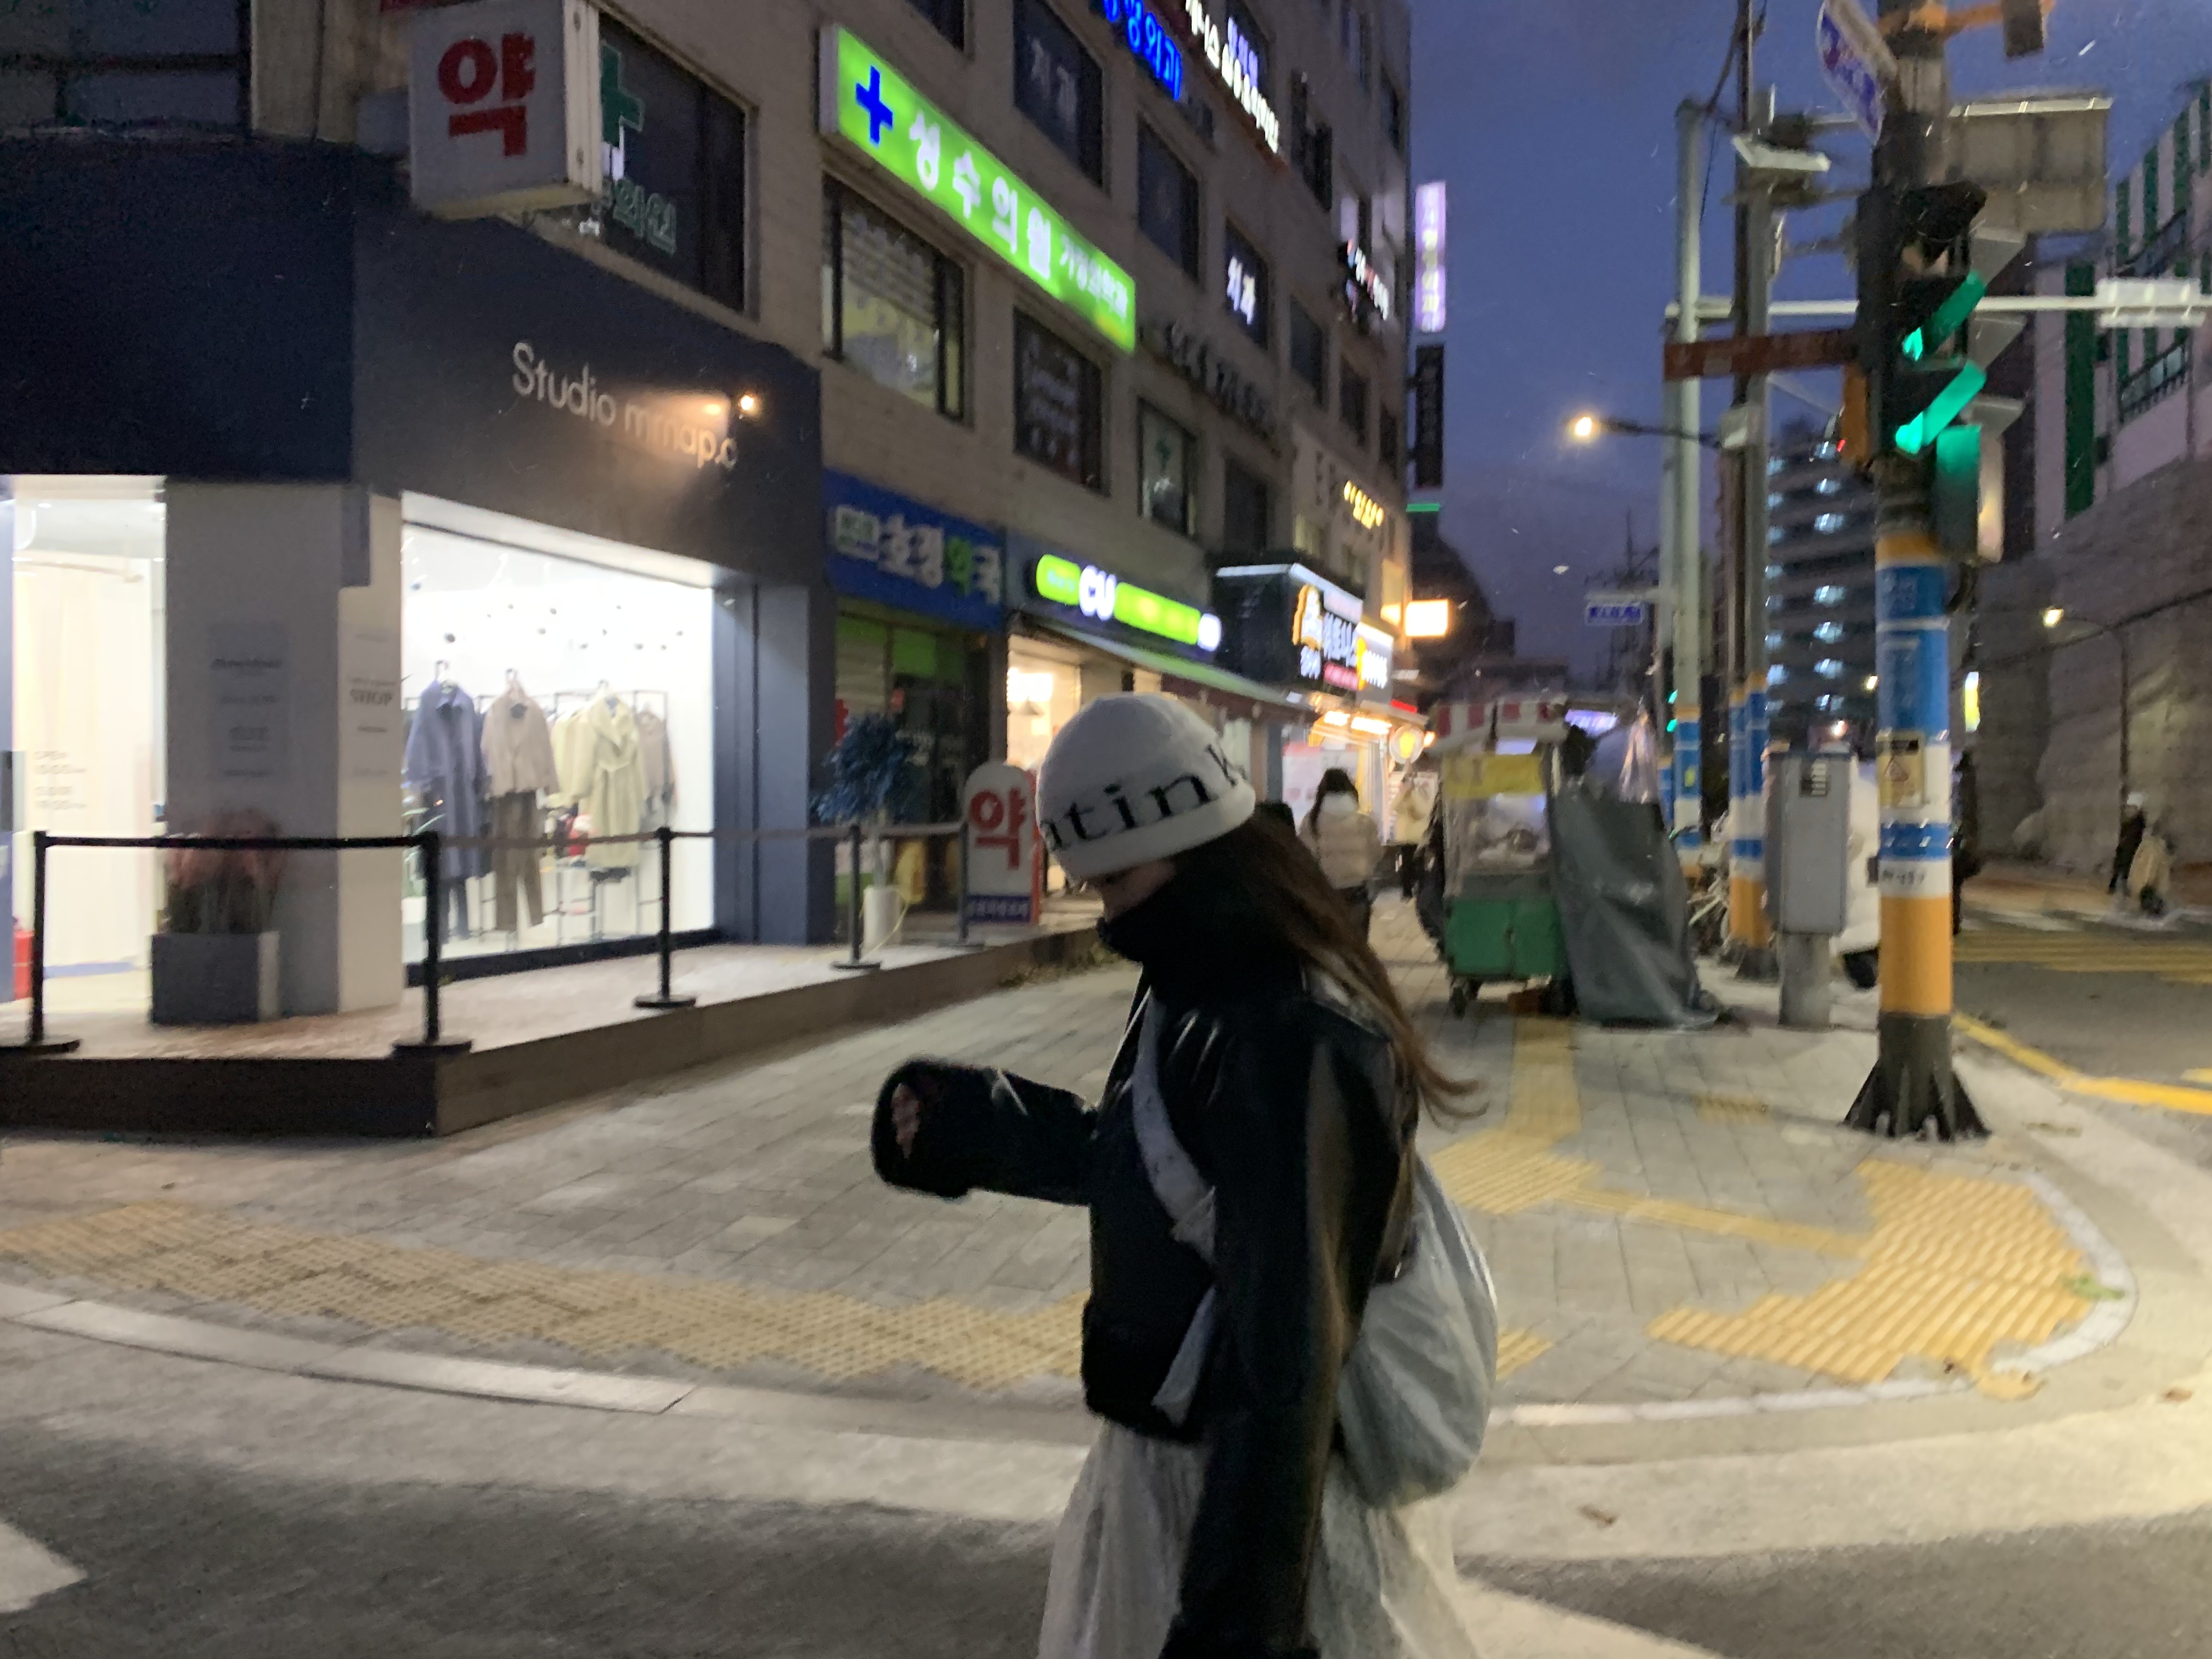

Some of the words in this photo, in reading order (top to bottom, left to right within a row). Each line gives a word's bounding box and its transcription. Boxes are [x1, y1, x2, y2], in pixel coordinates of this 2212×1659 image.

[438, 32, 536, 157] 약
[512, 340, 616, 426] Studio
[1079, 564, 1116, 621] CU
[969, 787, 1026, 871] 약
